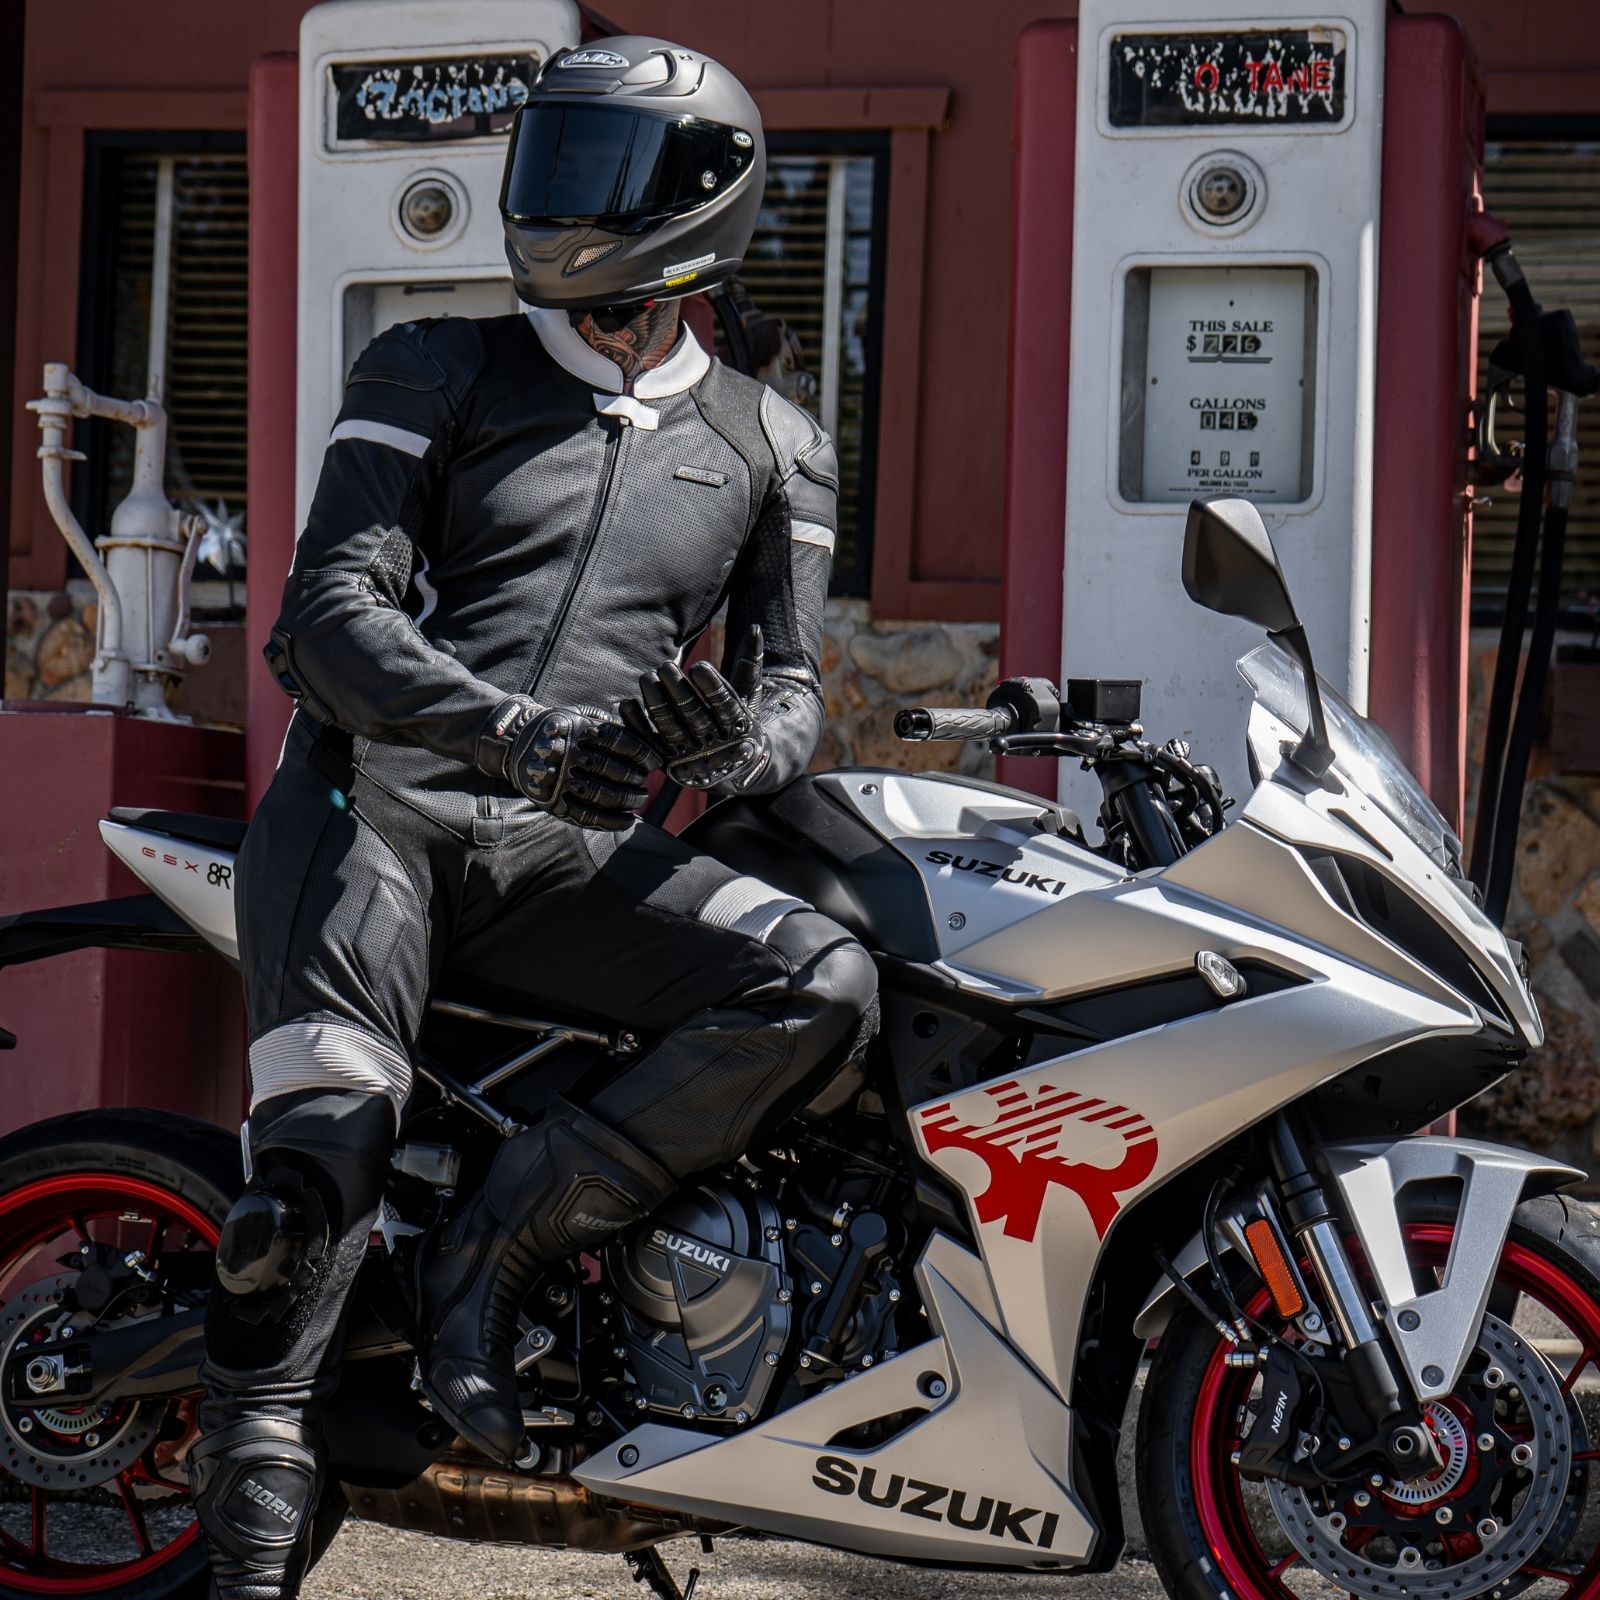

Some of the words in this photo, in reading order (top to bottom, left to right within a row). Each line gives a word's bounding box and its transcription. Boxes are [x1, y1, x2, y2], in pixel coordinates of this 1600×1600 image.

[1189, 320, 1226, 332] THIS
[1232, 320, 1273, 333] SALE
[1189, 398, 1267, 411] GALLONS
[1187, 468, 1210, 478] PER
[1213, 469, 1263, 479] GALLON
[206, 862, 232, 890] 8R
[925, 850, 1067, 896] SUZUKI
[652, 1229, 730, 1272] SUZUKI
[812, 1455, 1060, 1549] SUZUKI
